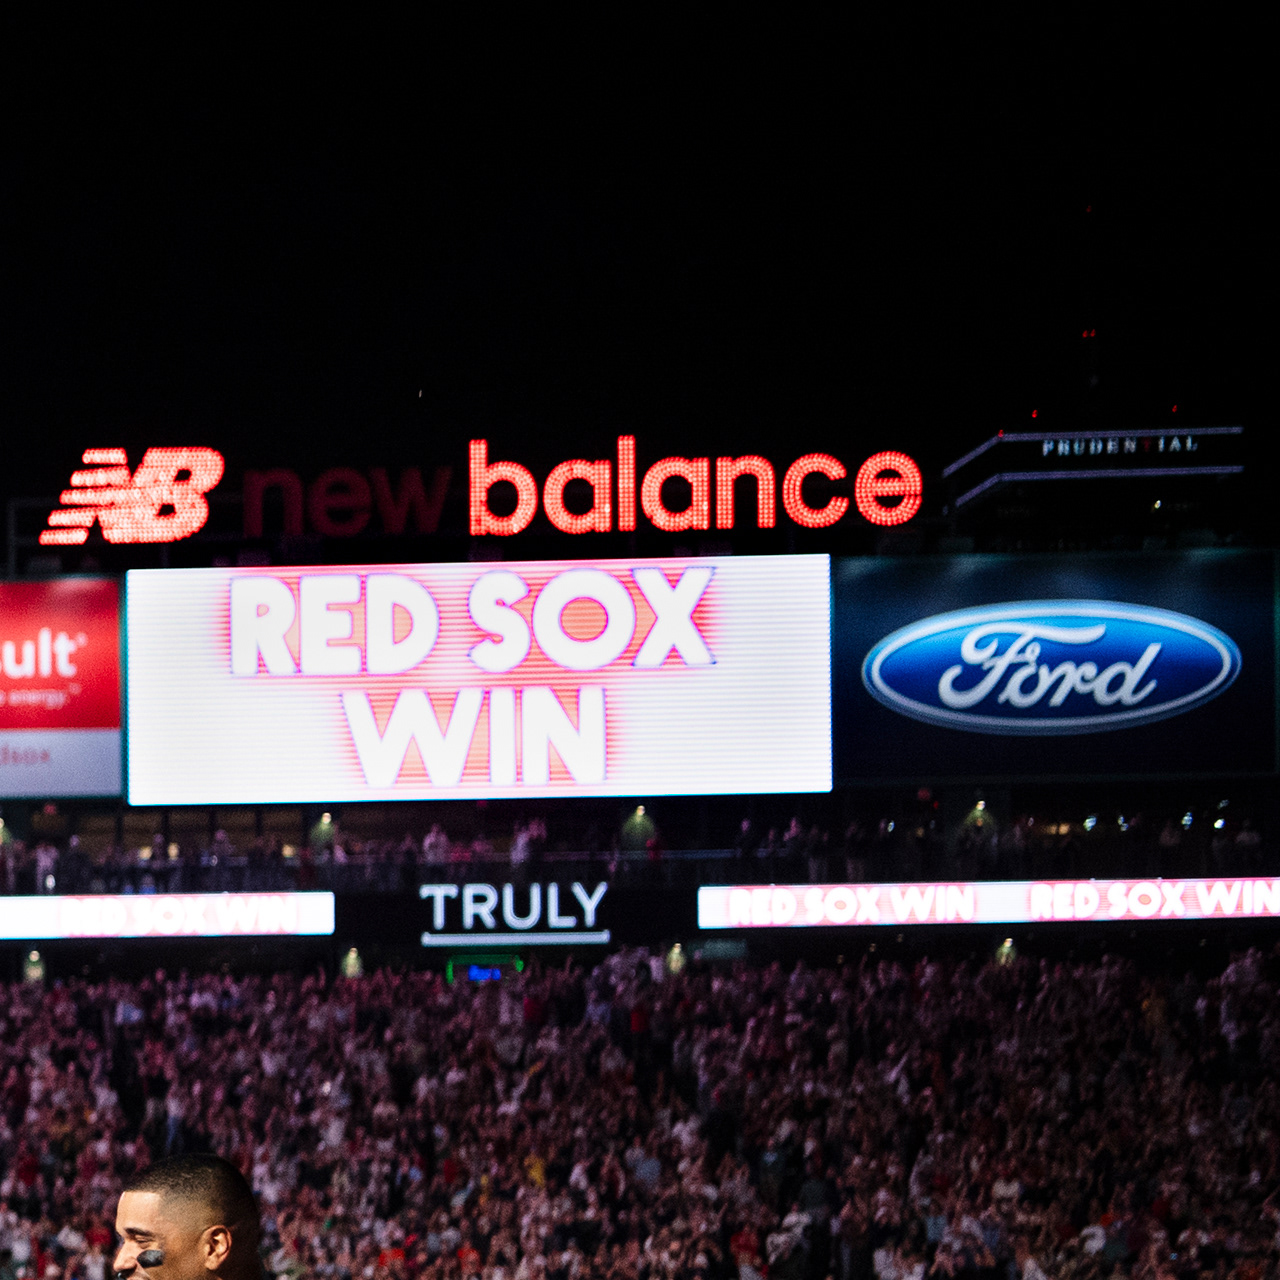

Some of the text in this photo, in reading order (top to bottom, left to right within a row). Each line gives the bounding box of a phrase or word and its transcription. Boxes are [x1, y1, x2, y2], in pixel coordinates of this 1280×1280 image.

[243, 466, 450, 540] new
[470, 435, 923, 535] balance
[230, 566, 717, 677] RED SOX
[937, 621, 1162, 708] Ford
[341, 687, 607, 786] WIN
[421, 880, 609, 930] TRULY
[729, 877, 1280, 926] RED SOX WIN RED SOX WIN
